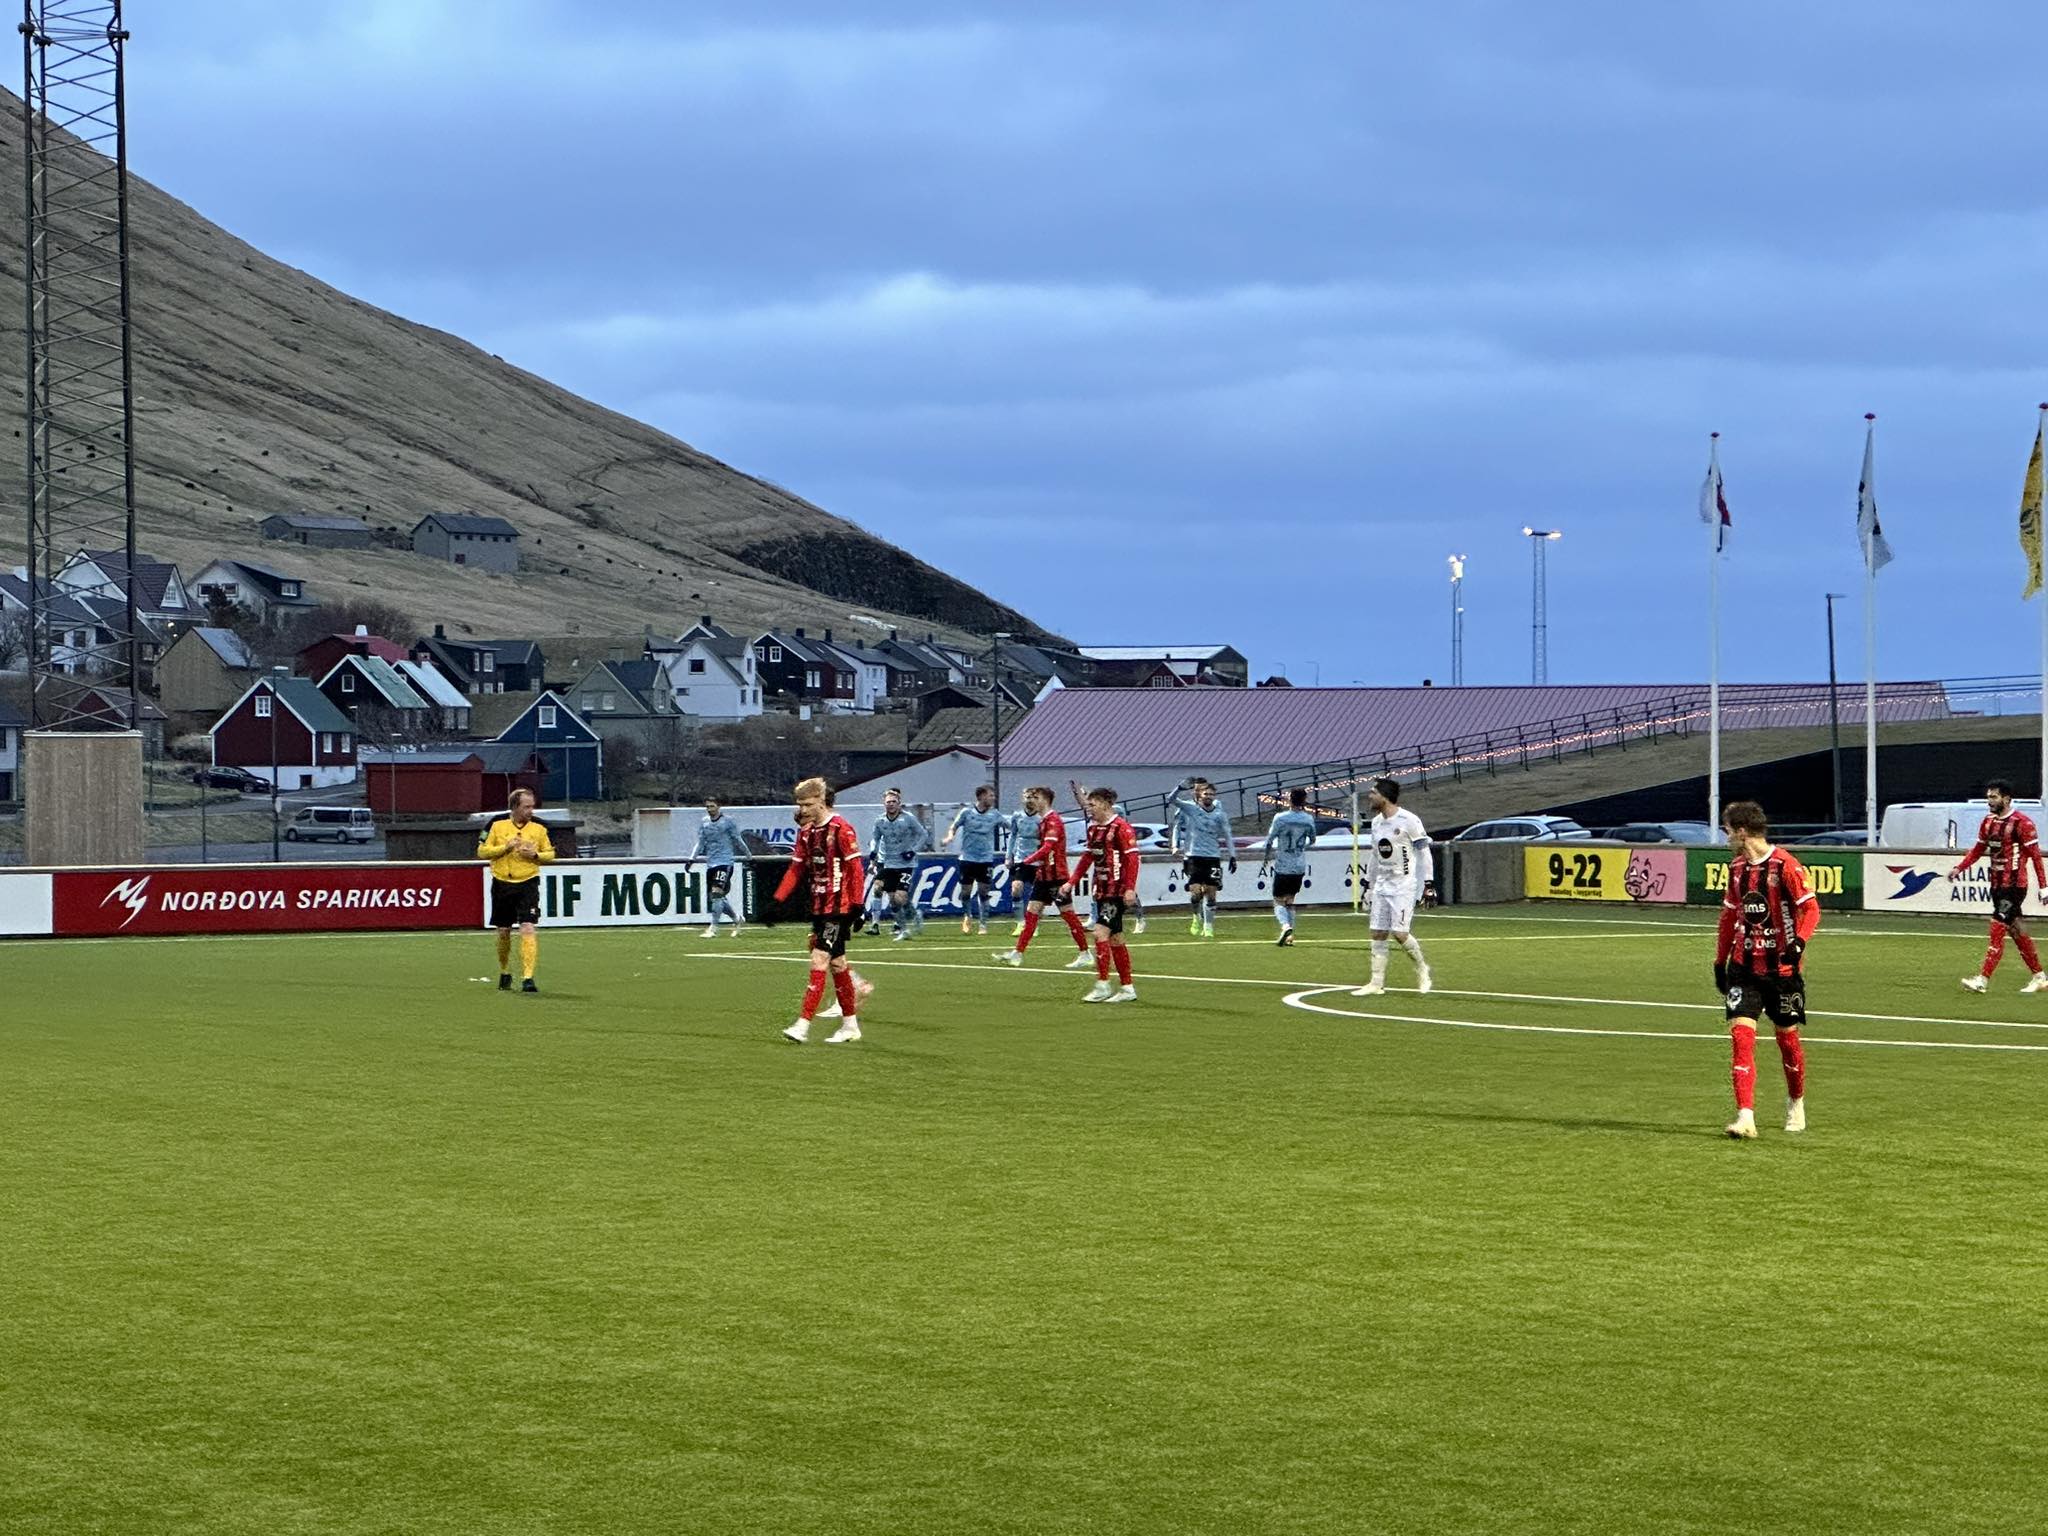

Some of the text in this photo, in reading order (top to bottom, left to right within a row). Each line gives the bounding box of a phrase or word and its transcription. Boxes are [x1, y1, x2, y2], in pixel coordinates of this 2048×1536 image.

[715, 870, 727, 881] 18
[900, 872, 912, 885] 22
[1549, 853, 1602, 887] 9-22
[1705, 862, 1730, 890] FA
[1802, 864, 1844, 894] NDI
[161, 888, 442, 911] NORÐOYA SPARIKASSI
[546, 872, 713, 918] IF MOH
[1951, 886, 1993, 902] AIRW
